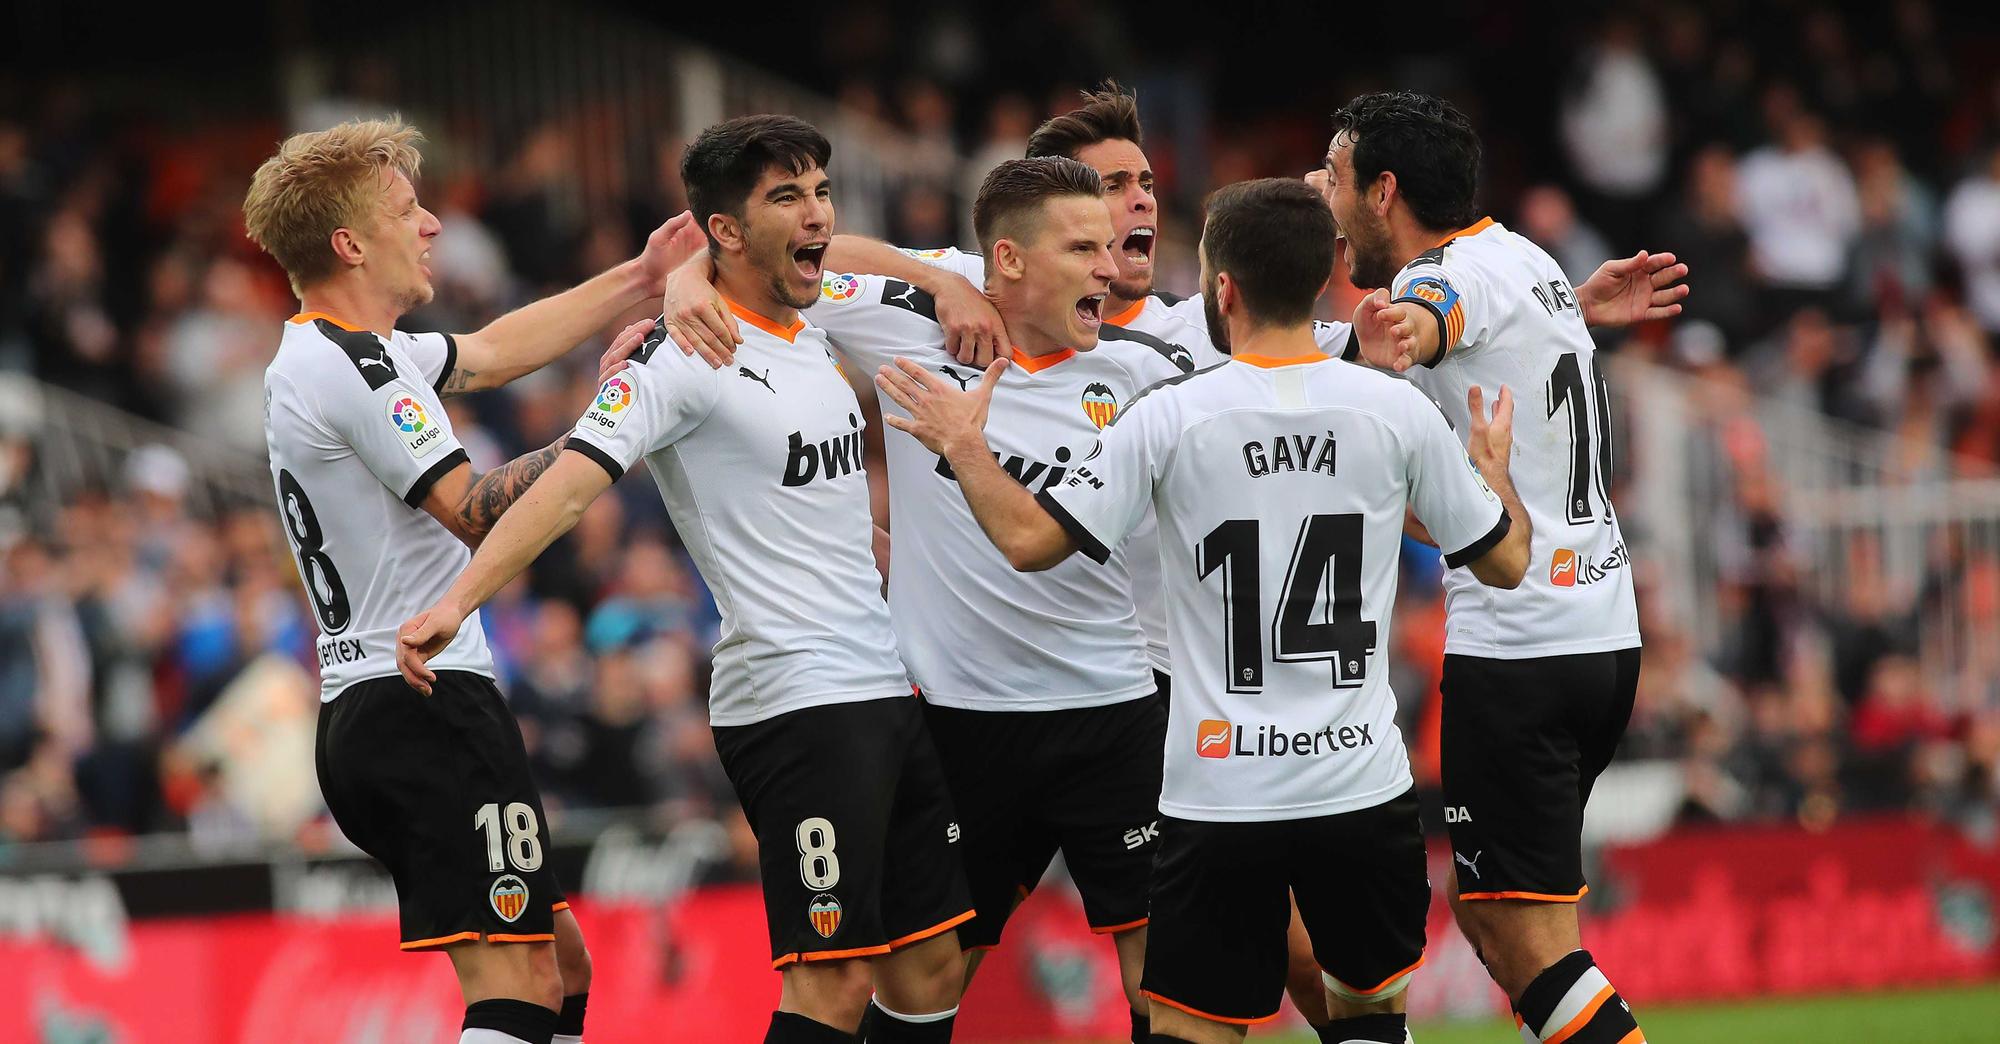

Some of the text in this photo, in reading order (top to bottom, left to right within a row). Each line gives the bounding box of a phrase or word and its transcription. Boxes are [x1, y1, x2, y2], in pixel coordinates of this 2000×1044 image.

[410, 427, 440, 450] LaLiga
[781, 412, 864, 487] bwi
[1242, 430, 1338, 479] GAYÀ
[1195, 513, 1377, 695] 14
[1235, 721, 1375, 758] Libertex
[474, 801, 544, 873] 18
[1443, 806, 1473, 823] DA
[795, 816, 841, 892] 8
